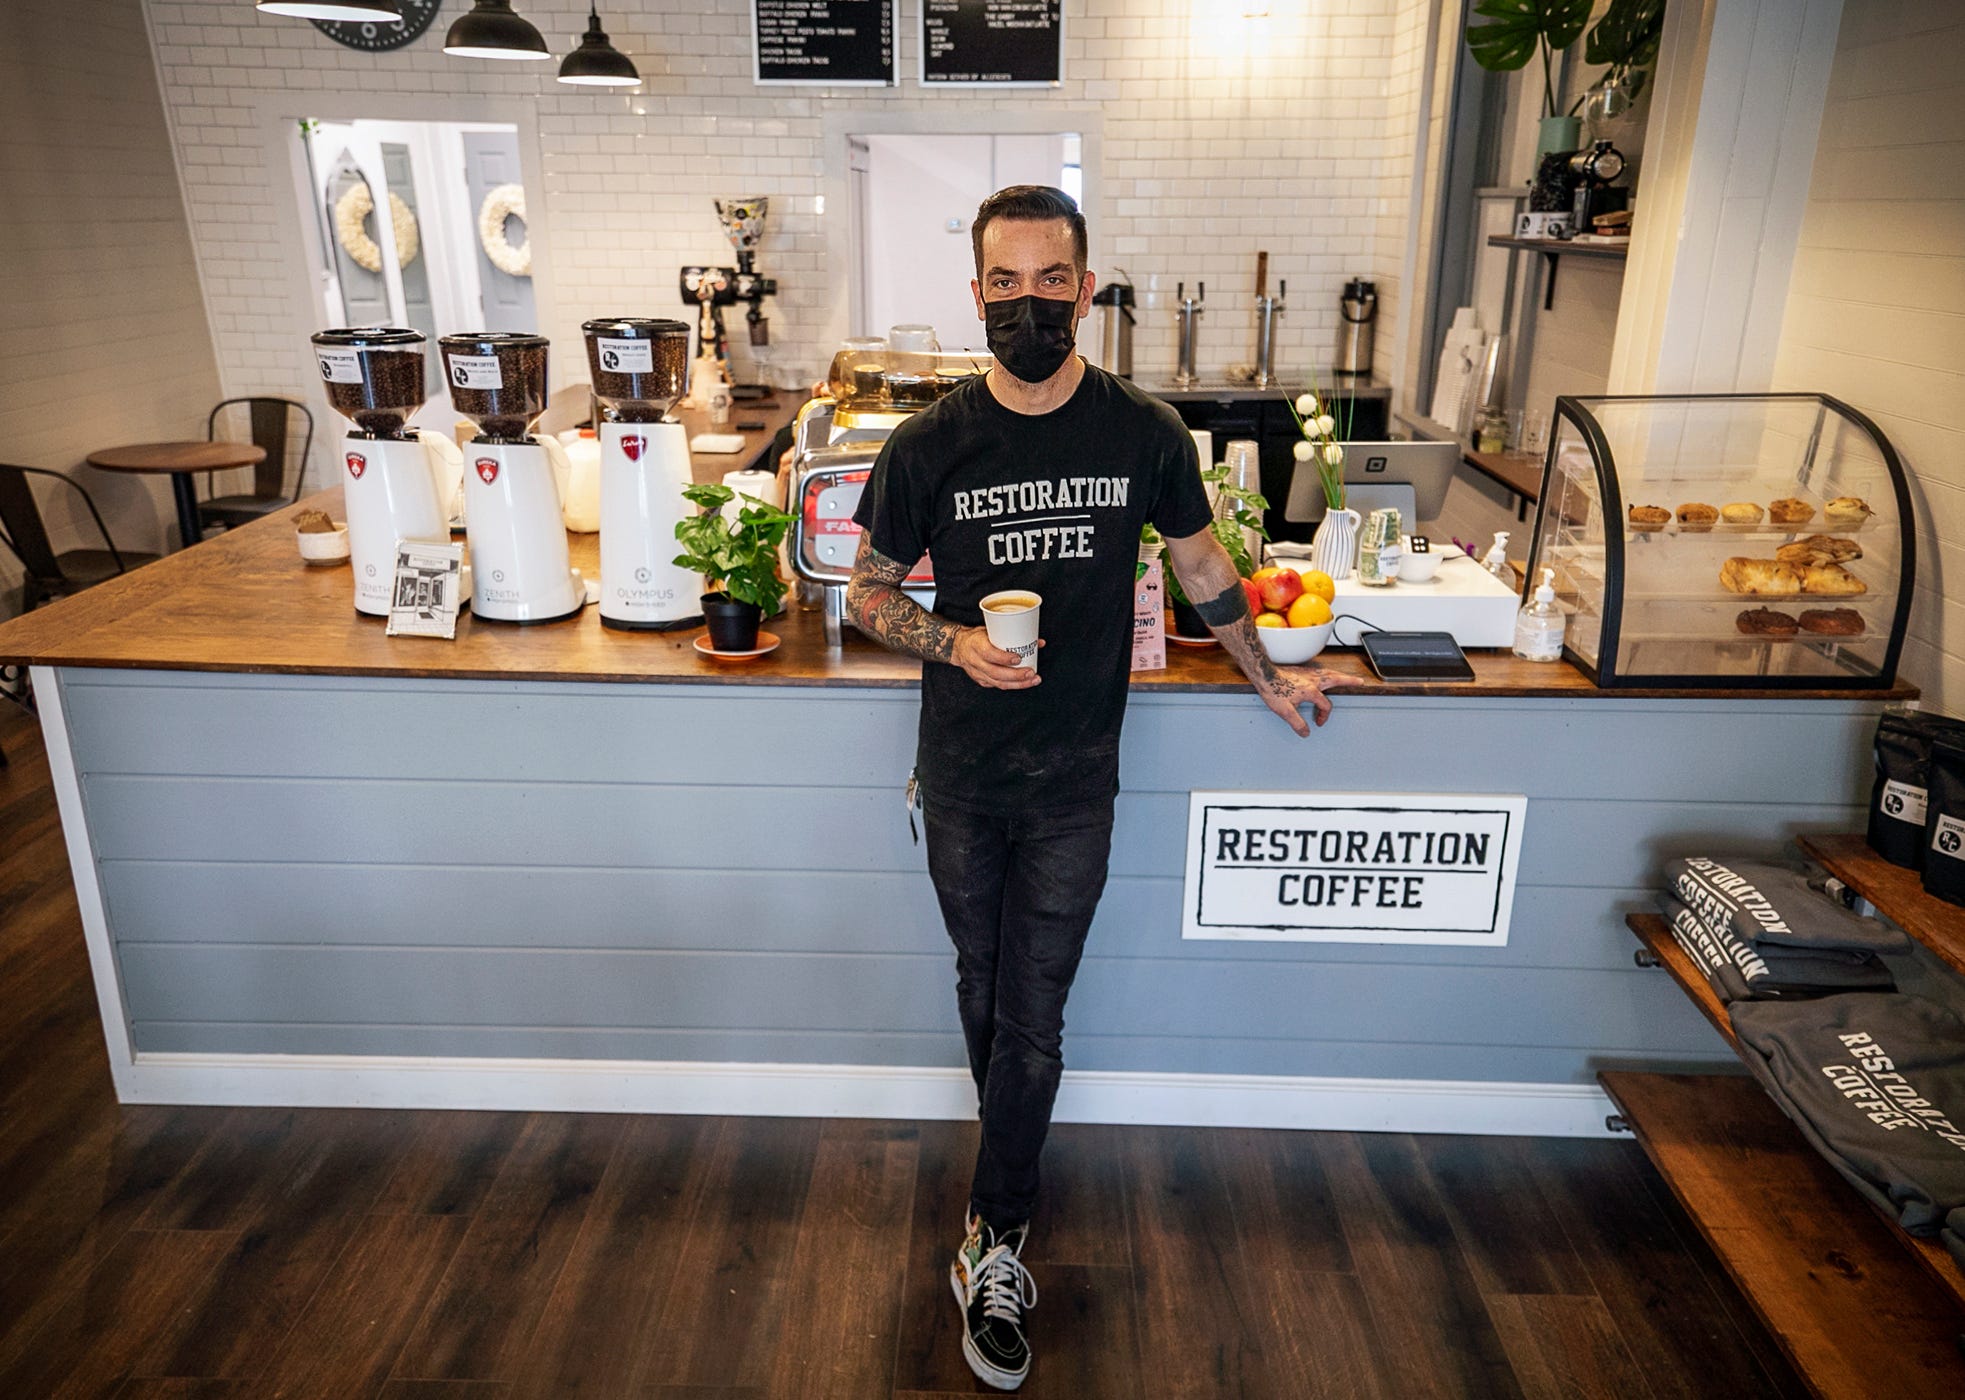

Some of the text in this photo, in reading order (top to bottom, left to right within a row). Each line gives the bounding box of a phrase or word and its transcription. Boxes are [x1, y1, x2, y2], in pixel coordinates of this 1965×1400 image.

[953, 477, 1130, 520] RESTORATION
[988, 525, 1095, 565] COFFEE
[617, 588, 675, 600] OLYMPUS
[1943, 821, 1965, 834] RESTOR
[1216, 828, 1491, 865] RESTORATION
[1278, 873, 1424, 909] COFFEE
[1822, 1065, 1918, 1131] COFFEE
